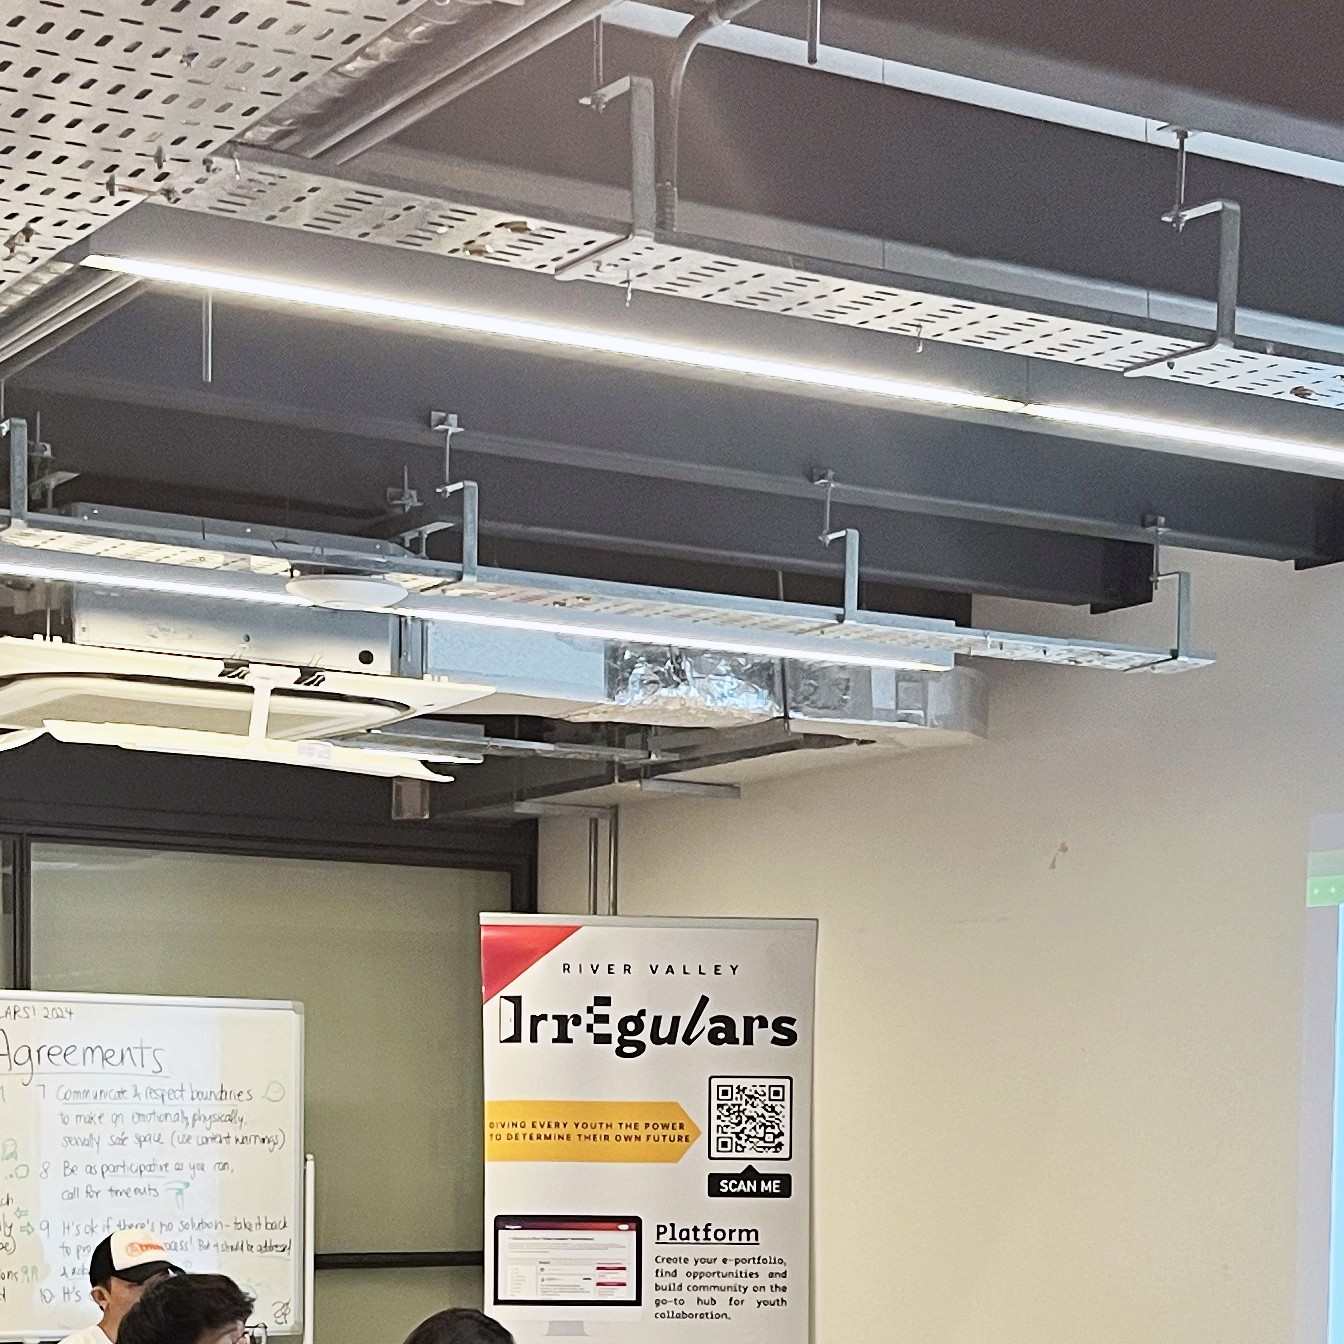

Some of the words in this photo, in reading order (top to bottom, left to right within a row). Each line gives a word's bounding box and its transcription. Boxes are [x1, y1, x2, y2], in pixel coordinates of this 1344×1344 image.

[562, 963, 633, 975] RIVER
[649, 964, 740, 976] VALLEY
[43, 1006, 74, 1021] 2024
[531, 1121, 568, 1129] EVERY
[573, 1121, 613, 1130] YOUTH
[617, 1122, 640, 1130] THE
[644, 1122, 686, 1131] POWER
[489, 1133, 502, 1141] TO
[506, 1133, 572, 1142] DETERMINE
[577, 1133, 610, 1142] THEIR
[614, 1134, 642, 1142] OWN
[646, 1134, 691, 1143] FUTURE
[719, 1179, 756, 1193] SCAN
[760, 1180, 781, 1193] ME
[655, 1222, 759, 1242] Platform
[654, 1255, 690, 1265] Create
[693, 1256, 717, 1267] your
[721, 1255, 788, 1267] e-portfolio,
[655, 1268, 678, 1278] find
[686, 1268, 760, 1280] opportunities
[768, 1270, 788, 1279] and
[654, 1282, 683, 1292] build
[686, 1283, 749, 1294] community
[752, 1284, 766, 1293] on
[770, 1283, 788, 1293] the
[654, 1297, 685, 1308] go-to
[696, 1296, 717, 1306] hub
[728, 1296, 745, 1306] for
[756, 1297, 788, 1309] youth
[654, 1310, 732, 1320] collaboration.
